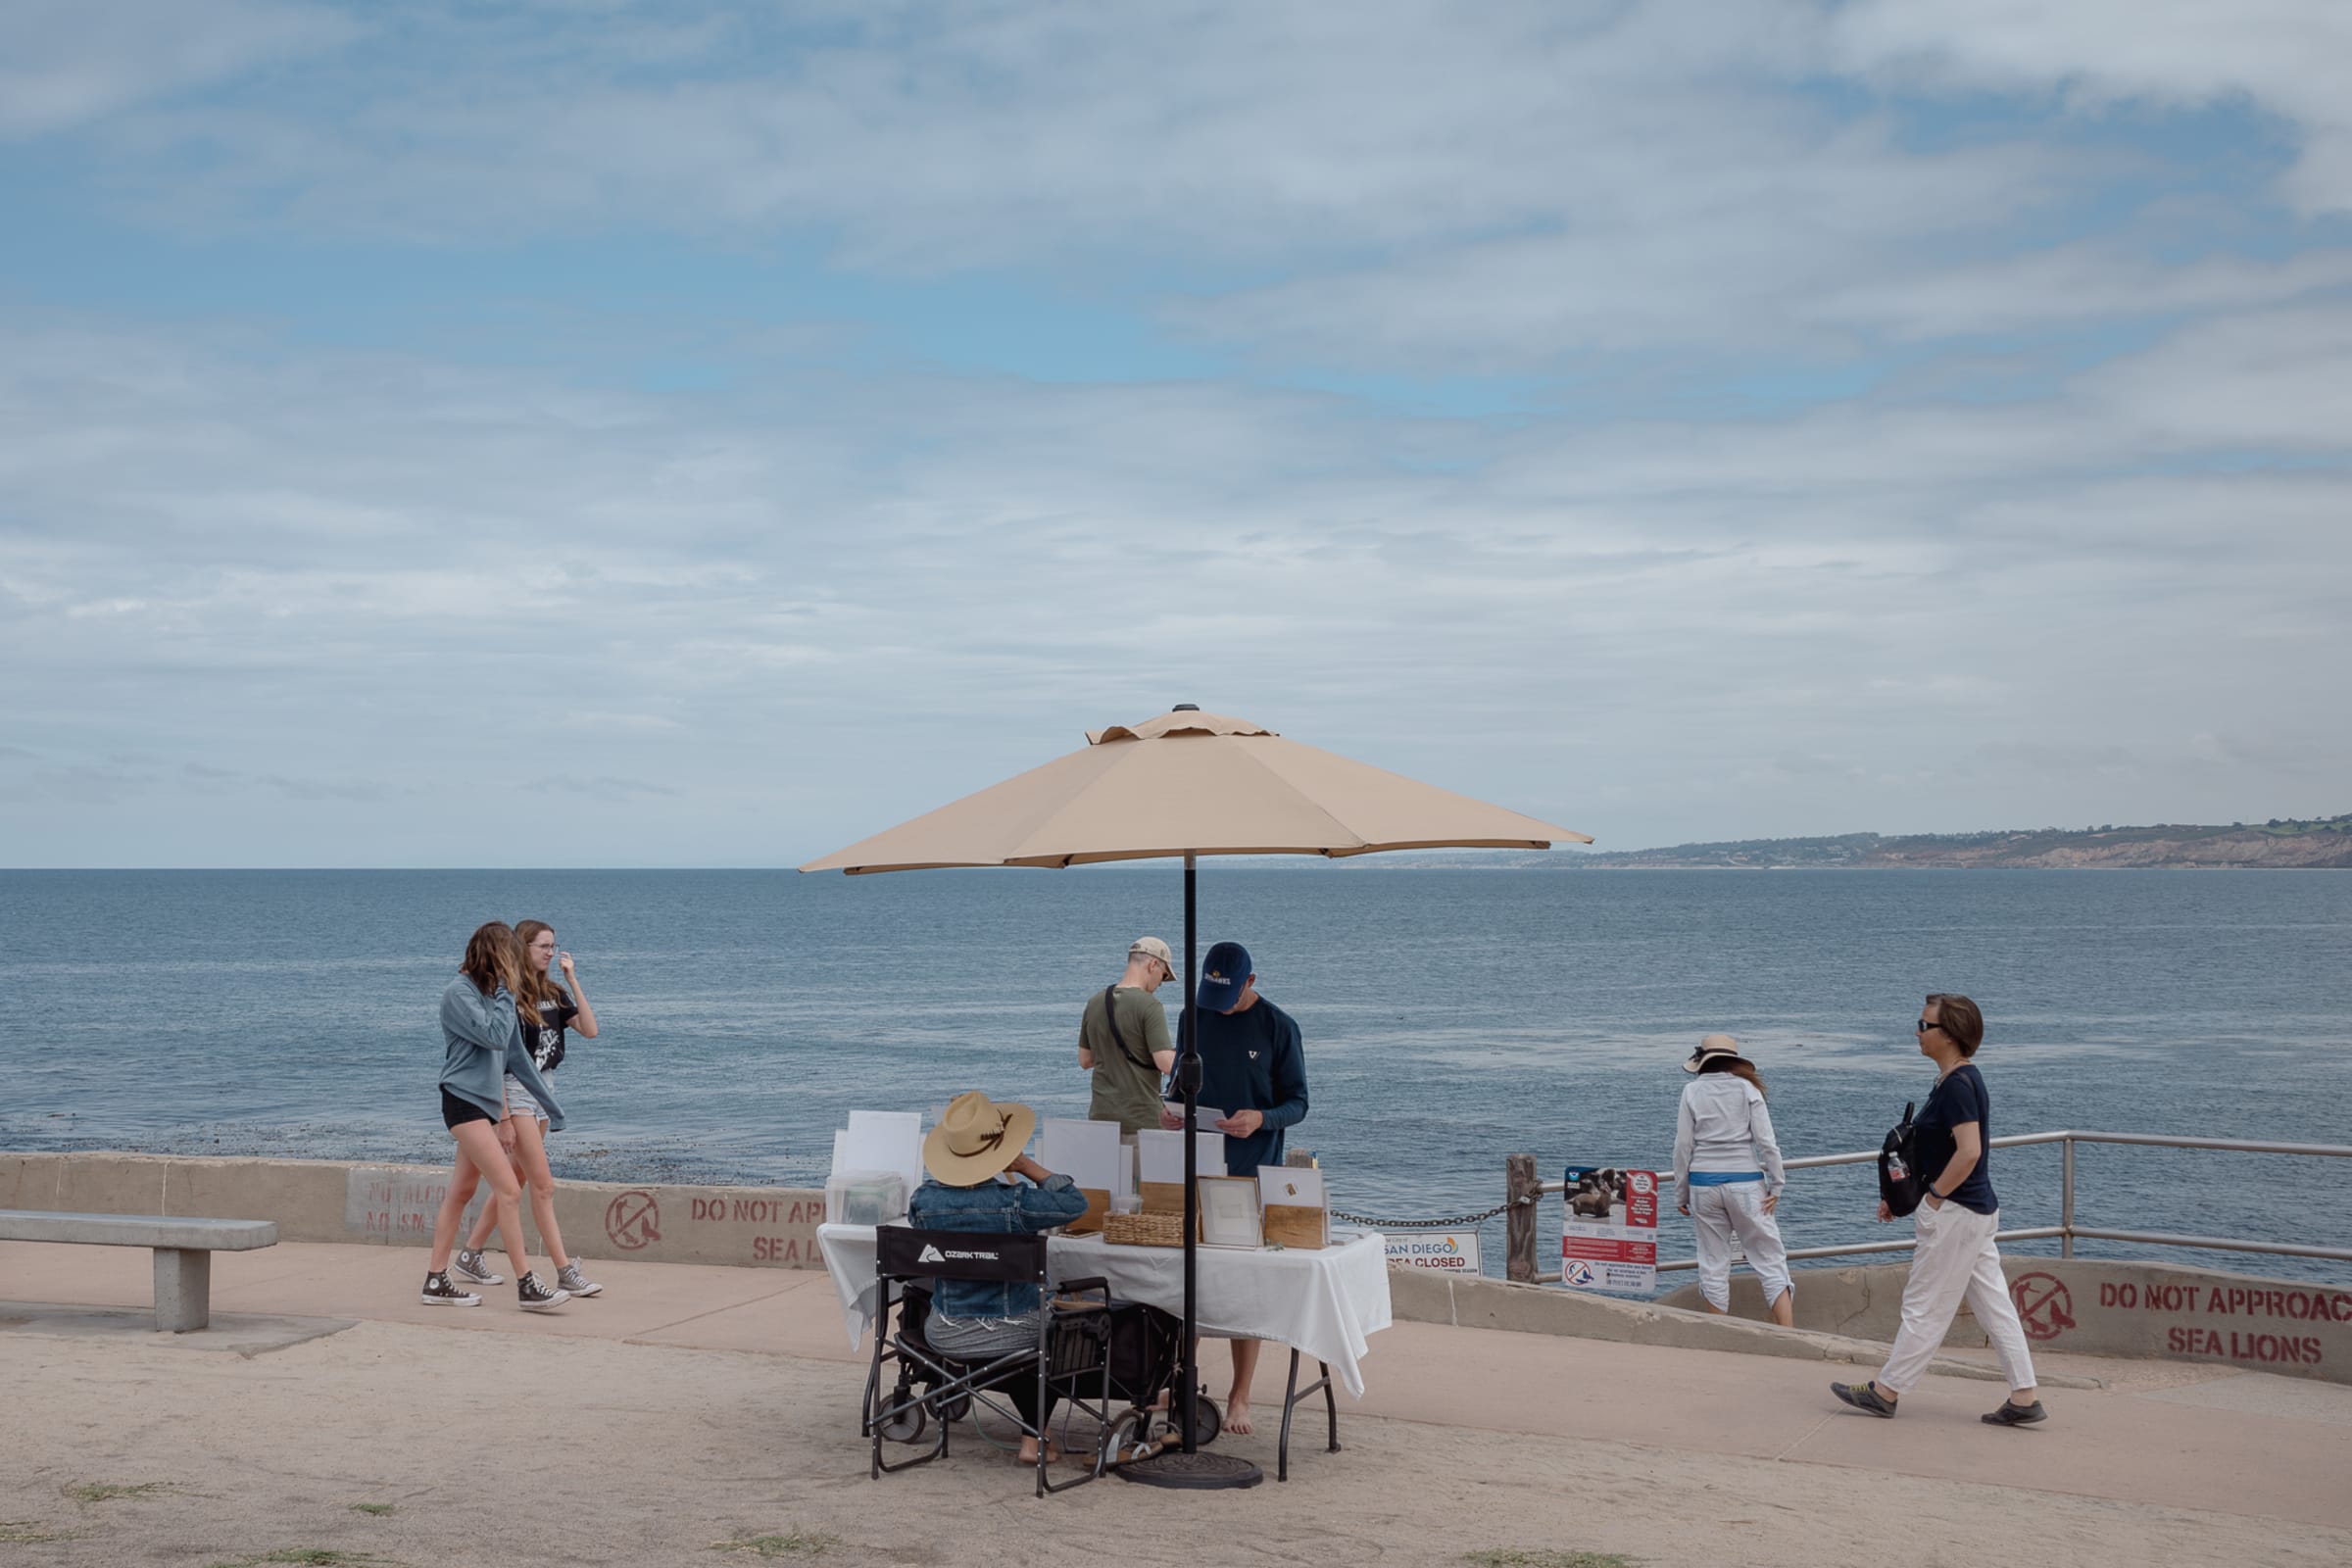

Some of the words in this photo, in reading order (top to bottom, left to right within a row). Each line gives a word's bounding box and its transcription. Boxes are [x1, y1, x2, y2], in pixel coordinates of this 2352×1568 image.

[691, 1199, 726, 1221] DO
[733, 1199, 784, 1223] NOT
[753, 1237, 800, 1261] SEA
[1412, 1243, 1452, 1254] DIEGO
[1415, 1257, 1465, 1268] CLOSED
[2100, 1282, 2137, 1308] DO
[2144, 1284, 2200, 1311] NOT
[2168, 1327, 2224, 1356] SEA
[2230, 1331, 2322, 1363] LIONS
